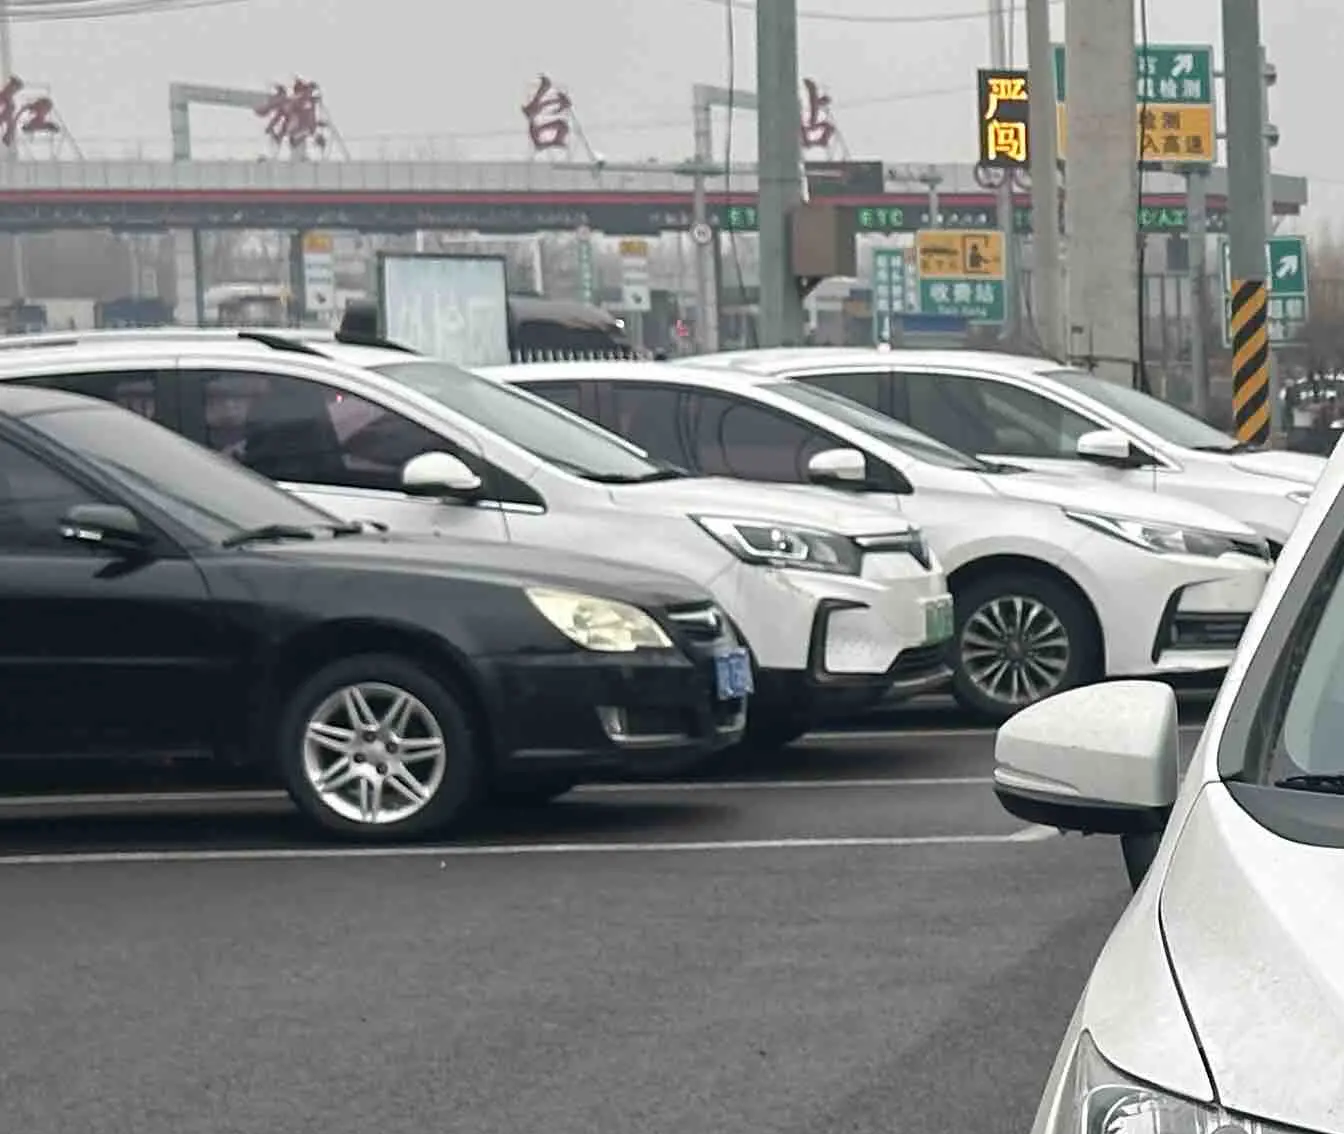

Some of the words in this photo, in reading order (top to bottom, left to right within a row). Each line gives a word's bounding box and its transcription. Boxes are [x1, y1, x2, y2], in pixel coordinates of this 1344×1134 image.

[860, 207, 904, 228] ETC
[929, 282, 995, 304] 收费站
